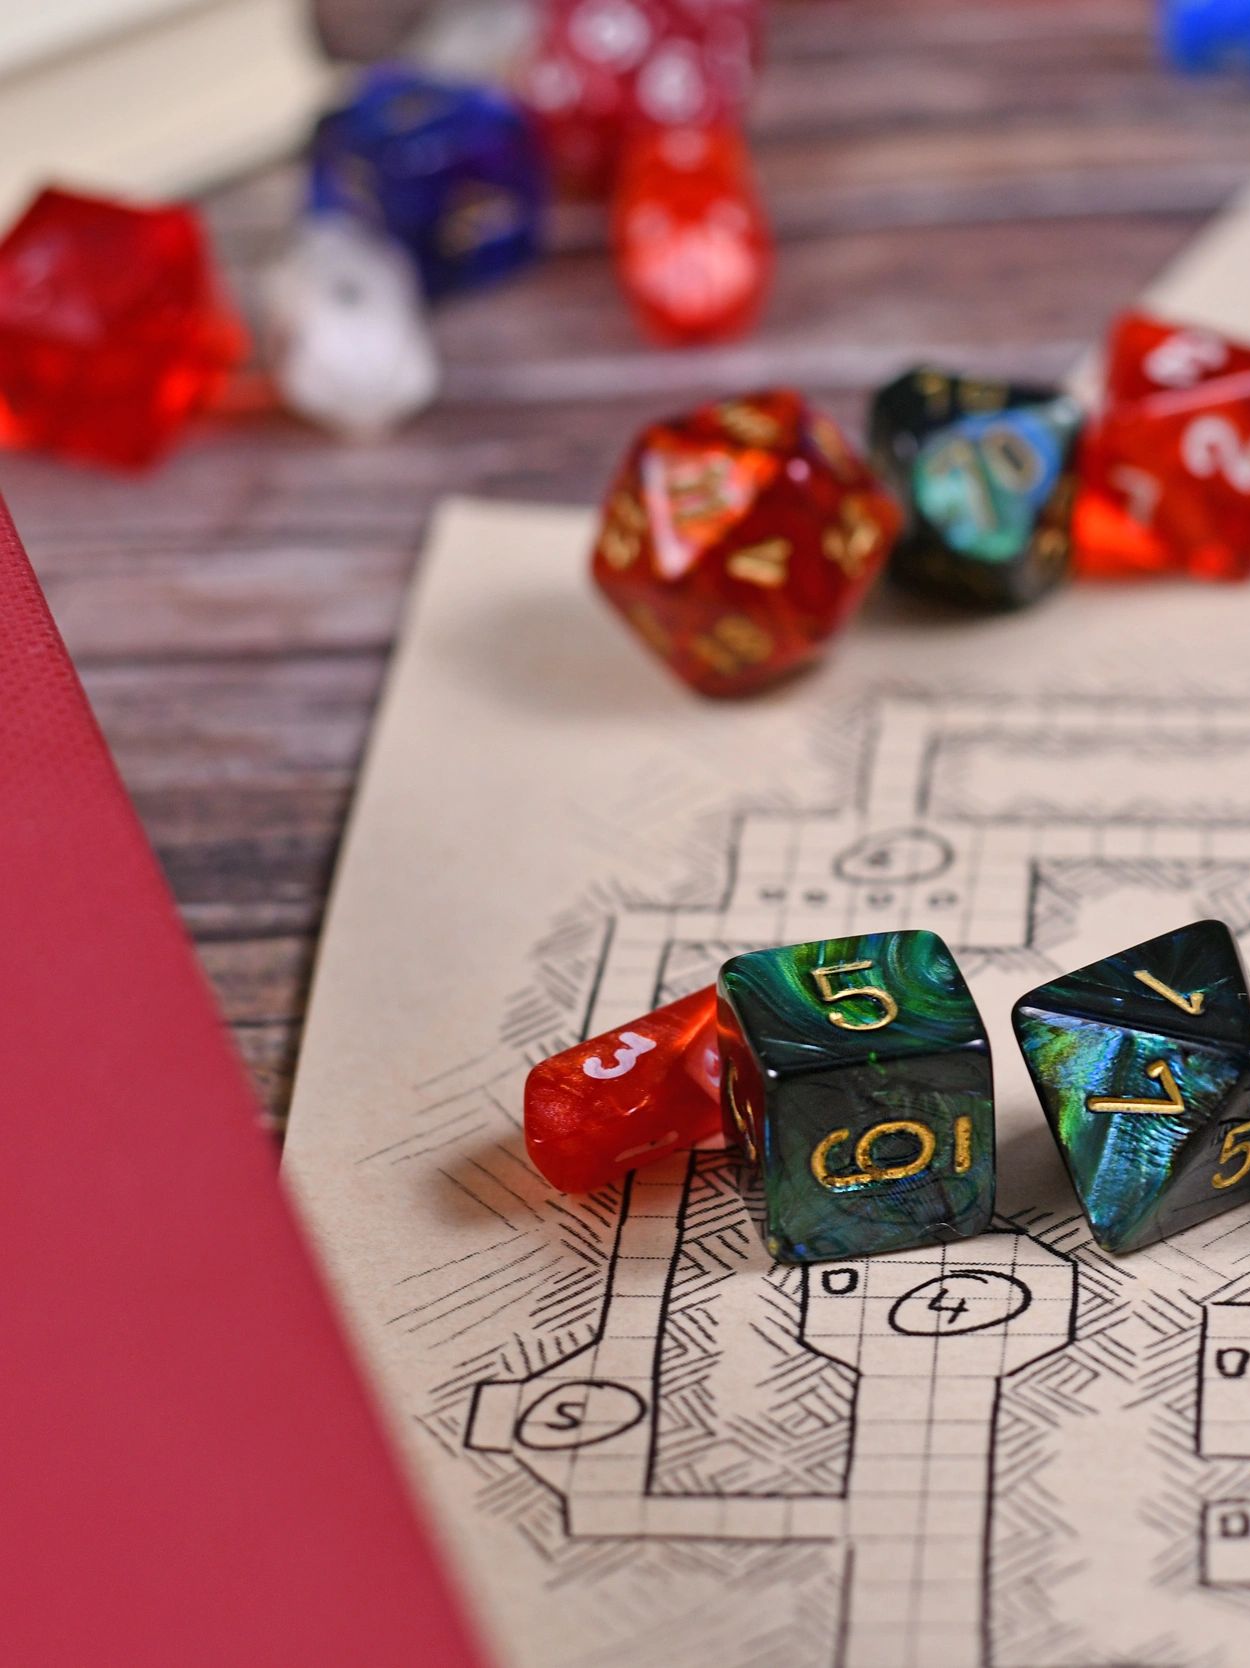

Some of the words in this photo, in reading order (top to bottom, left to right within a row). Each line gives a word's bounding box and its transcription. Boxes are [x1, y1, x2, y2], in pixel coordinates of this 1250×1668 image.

[811, 960, 898, 1031] 5
[582, 1030, 657, 1079] 3
[1086, 1058, 1186, 1114] 7
[927, 1288, 967, 1324] 4
